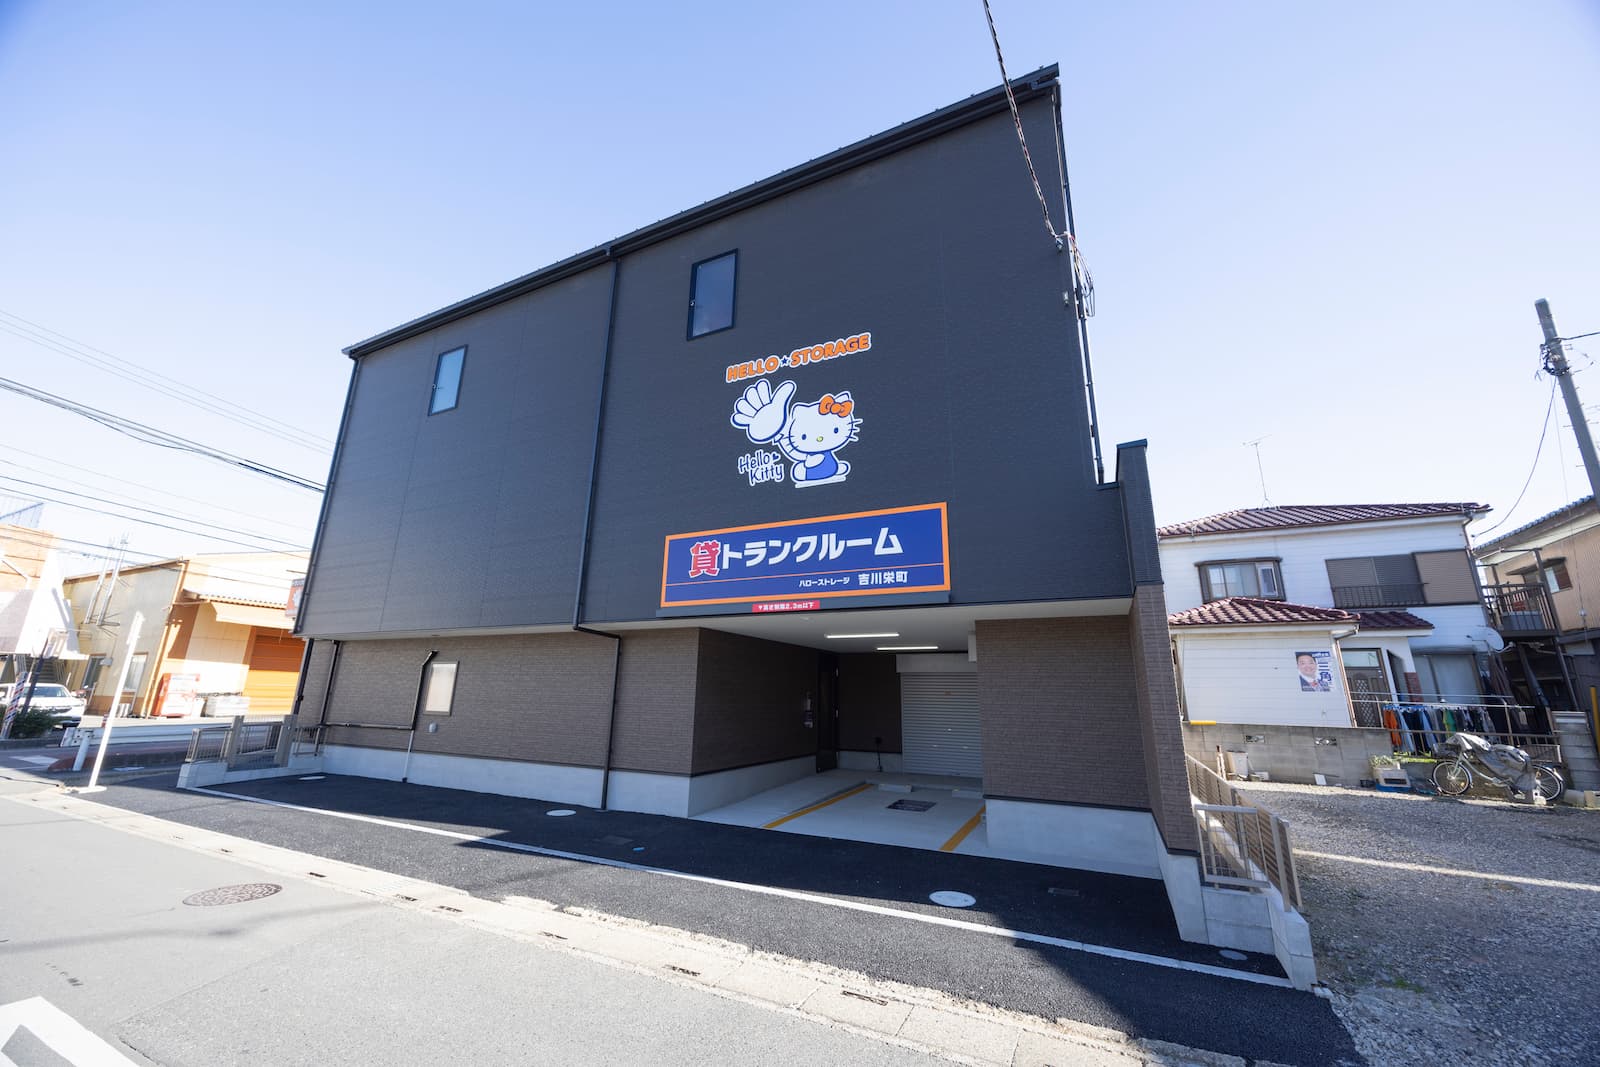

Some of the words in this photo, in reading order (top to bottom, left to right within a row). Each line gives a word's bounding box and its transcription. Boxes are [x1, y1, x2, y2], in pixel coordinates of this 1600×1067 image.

[726, 356, 780, 382] HELLO
[789, 333, 871, 367] STORAGE
[739, 450, 771, 473] Hello
[750, 464, 784, 485] Kitty
[799, 577, 850, 587] ハローストレージ
[858, 571, 908, 586] 吉川栄町
